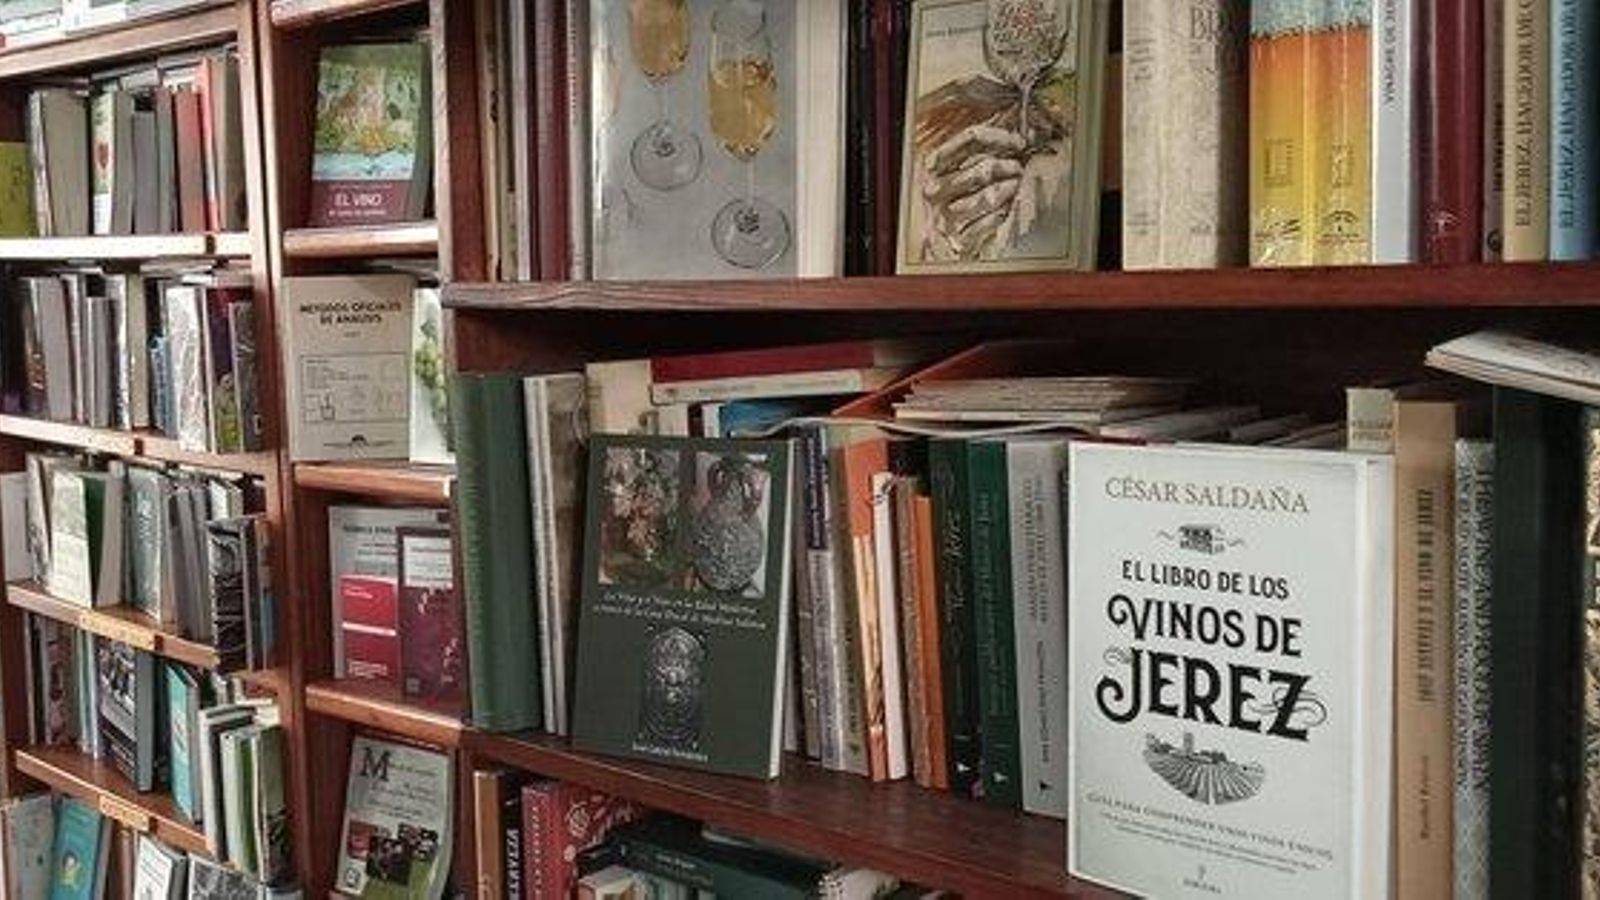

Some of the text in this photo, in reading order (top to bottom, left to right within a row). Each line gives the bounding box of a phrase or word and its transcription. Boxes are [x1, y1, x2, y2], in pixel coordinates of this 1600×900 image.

[334, 192, 382, 206] EL VINO
[1105, 476, 1311, 515] CÉSAR SALDAÑA
[1122, 560, 1290, 600] EL LIBRO DE LOS
[1107, 594, 1303, 657] VINOS DE
[1095, 646, 1326, 743] JEREZ
